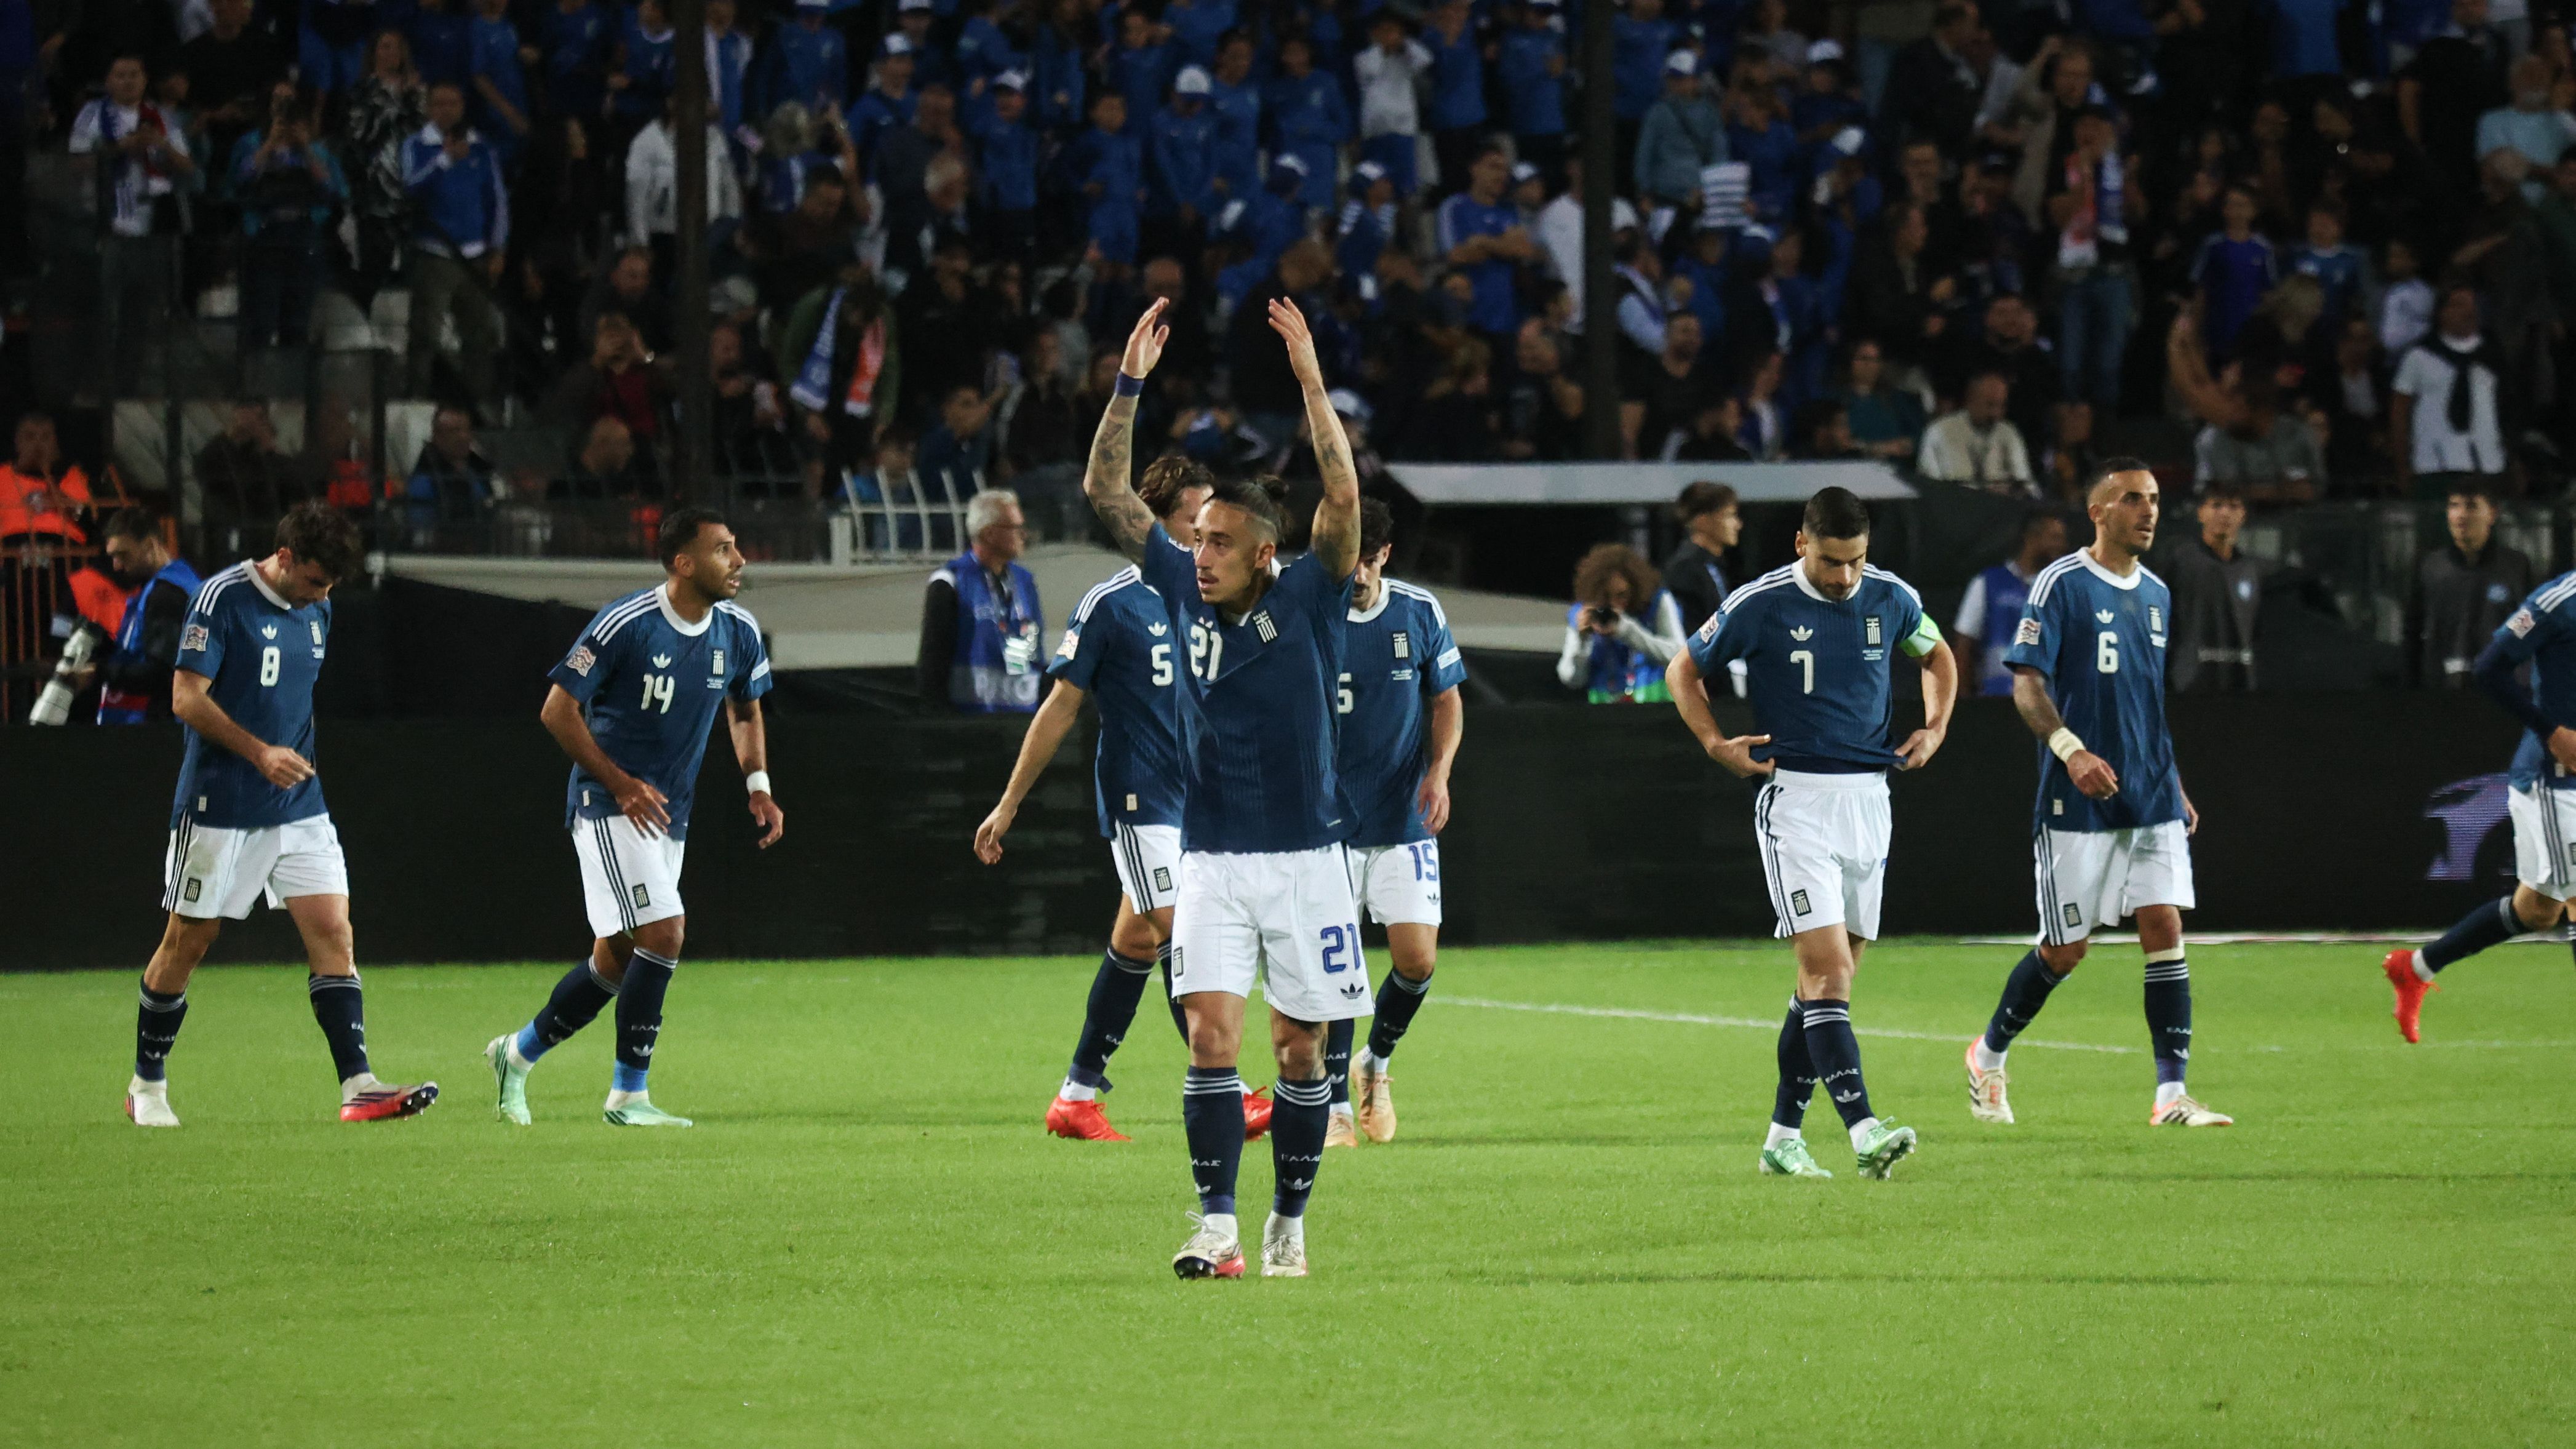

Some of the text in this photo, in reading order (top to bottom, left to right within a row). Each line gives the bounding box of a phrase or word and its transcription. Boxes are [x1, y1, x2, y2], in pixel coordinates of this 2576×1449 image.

[260, 646, 281, 687] 8
[1150, 643, 1174, 687] 5
[1190, 625, 1223, 682] 21
[1790, 650, 1814, 695] 7
[2097, 631, 2119, 674] 6
[640, 673, 675, 714] 14
[1337, 672, 1354, 714] 5
[1408, 843, 1438, 881] 15
[1320, 922, 1361, 974] 21
